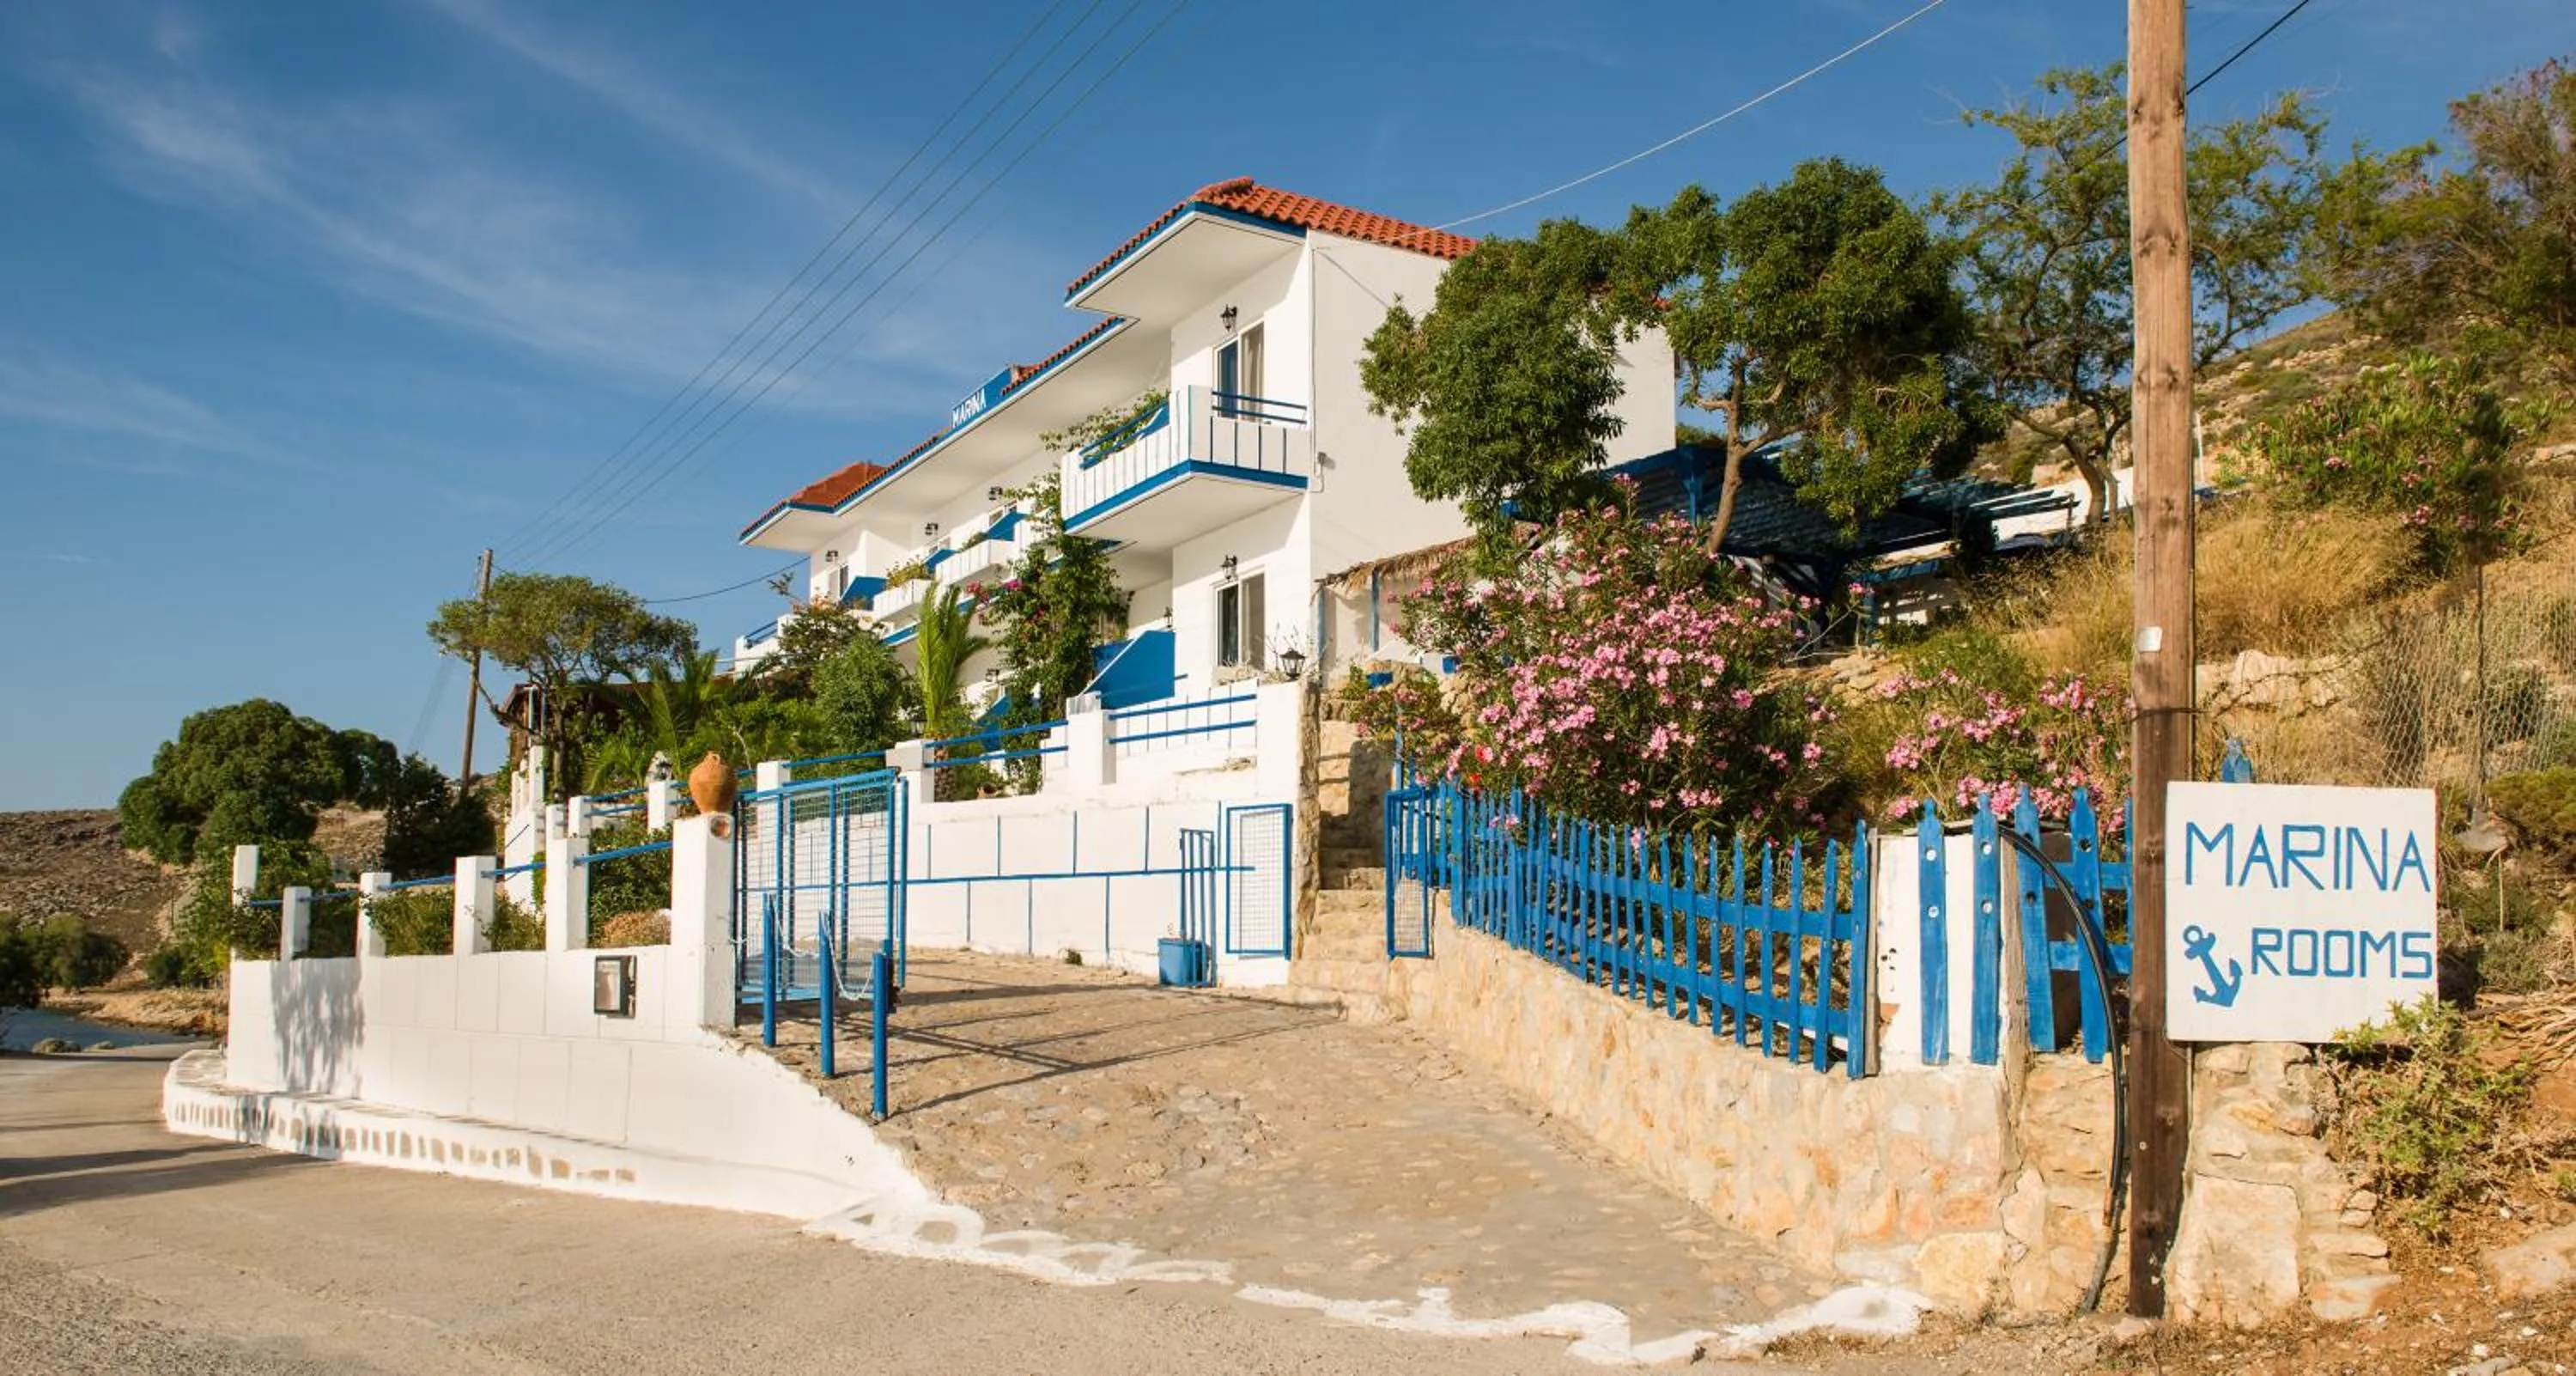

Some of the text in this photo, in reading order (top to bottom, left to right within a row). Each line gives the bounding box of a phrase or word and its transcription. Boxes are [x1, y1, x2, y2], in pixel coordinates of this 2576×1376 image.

[952, 388, 987, 428] MARINA
[2185, 821, 2431, 892] MARINA
[2251, 927, 2433, 978] ROOMS
